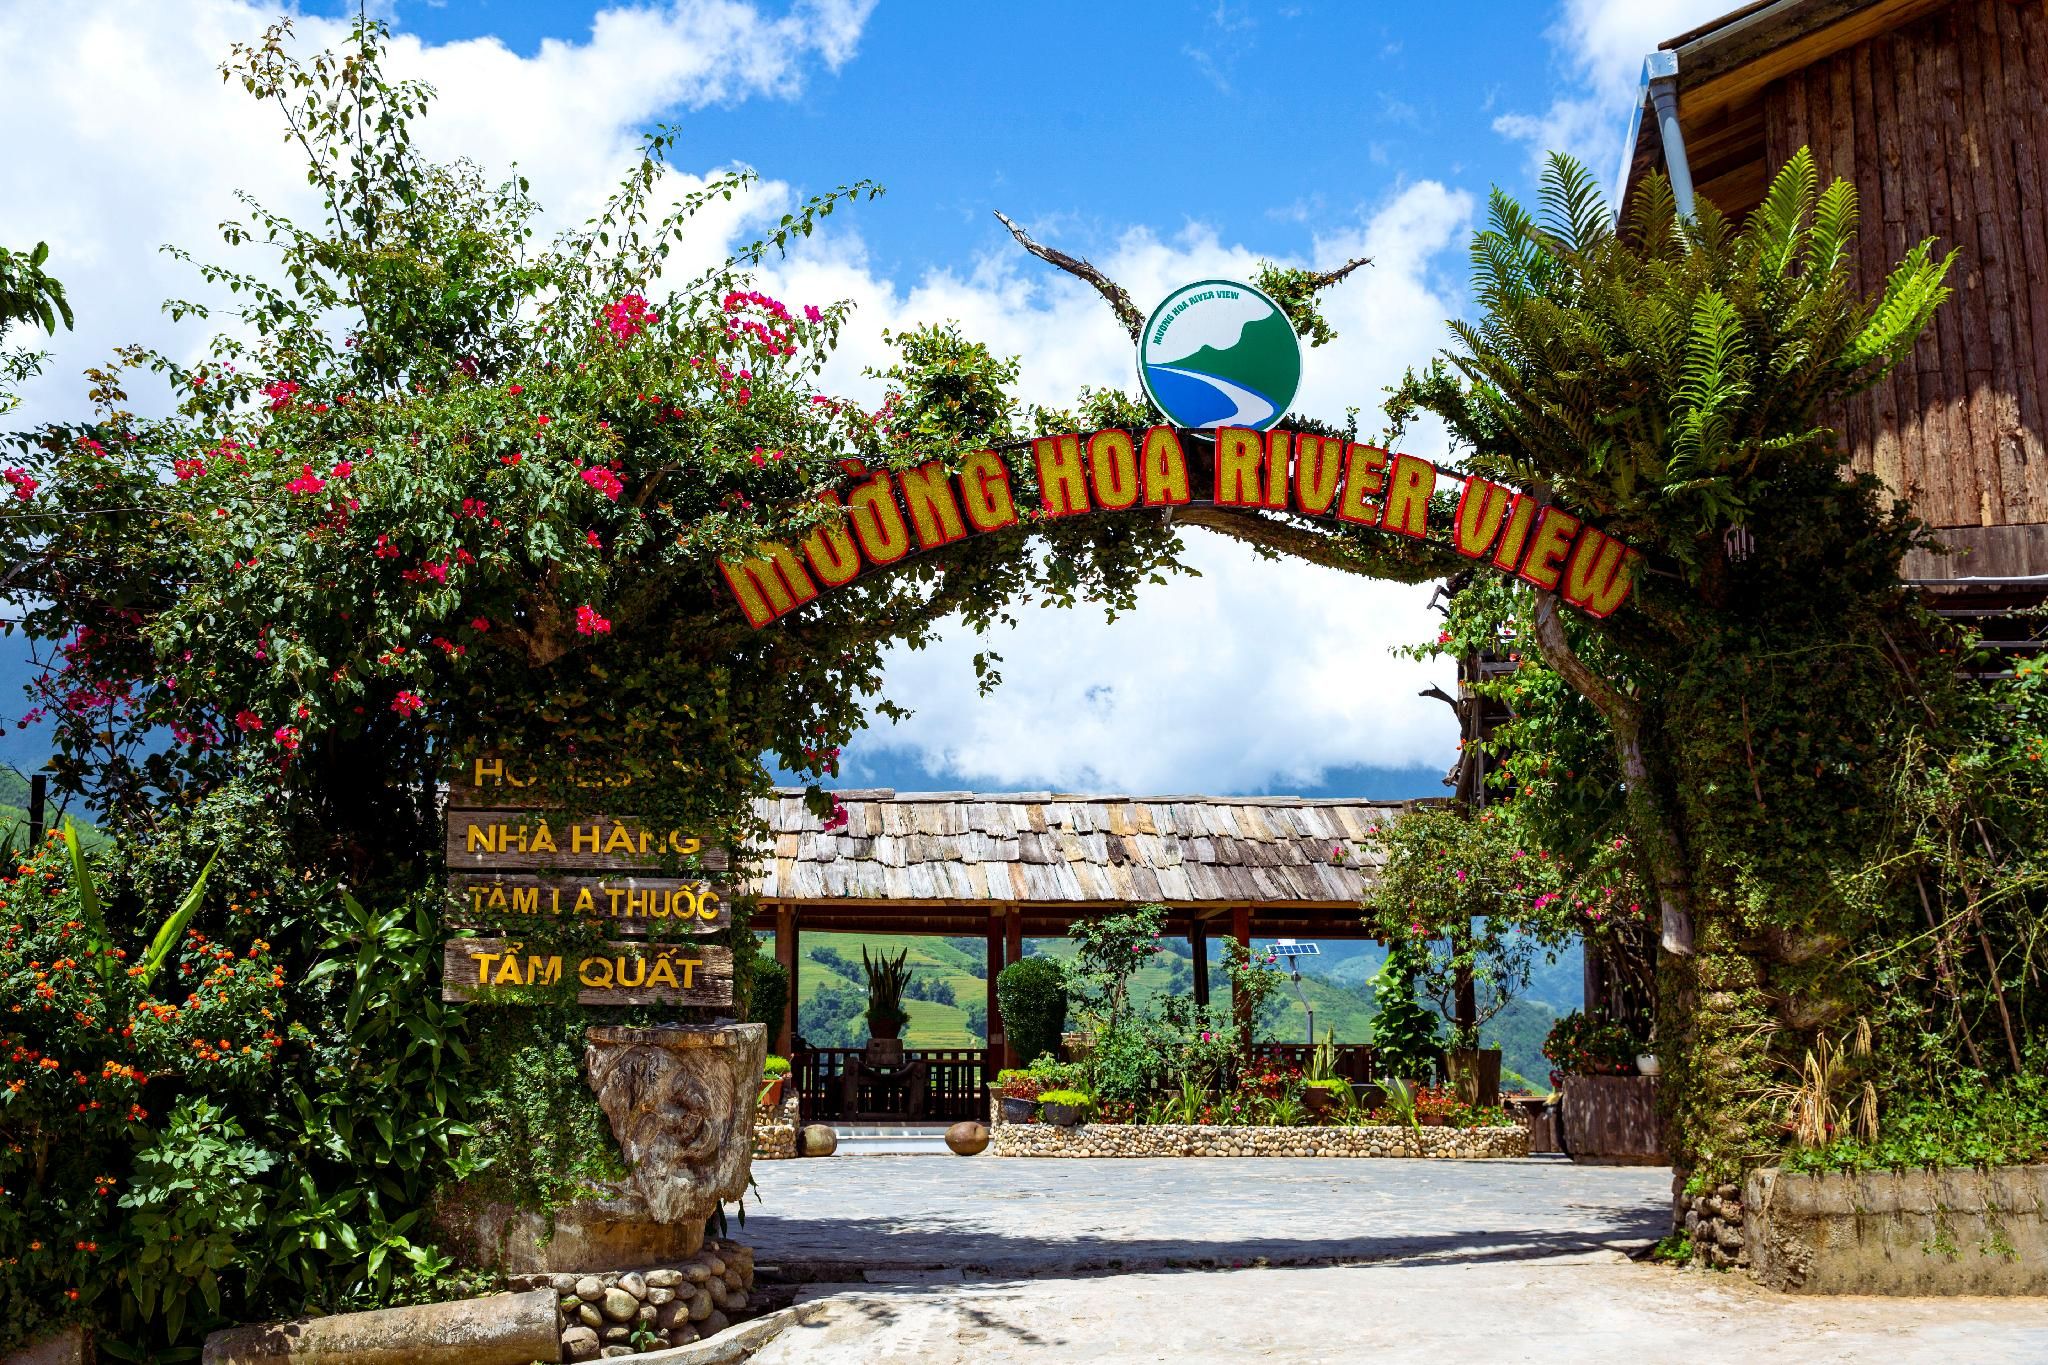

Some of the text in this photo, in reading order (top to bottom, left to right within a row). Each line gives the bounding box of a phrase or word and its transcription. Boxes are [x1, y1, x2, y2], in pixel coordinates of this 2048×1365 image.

[1172, 301, 1189, 316] HOA
[1188, 291, 1215, 305] RIVER
[1216, 290, 1240, 300] VIEW
[1032, 424, 1190, 518] HOA
[1214, 425, 1437, 539] RIVER
[1453, 475, 1643, 618] VIEW
[467, 818, 701, 855] NHÀ HÀNG
[605, 881, 720, 920] THUỐC
[470, 941, 703, 989] TẨM QUẤT
